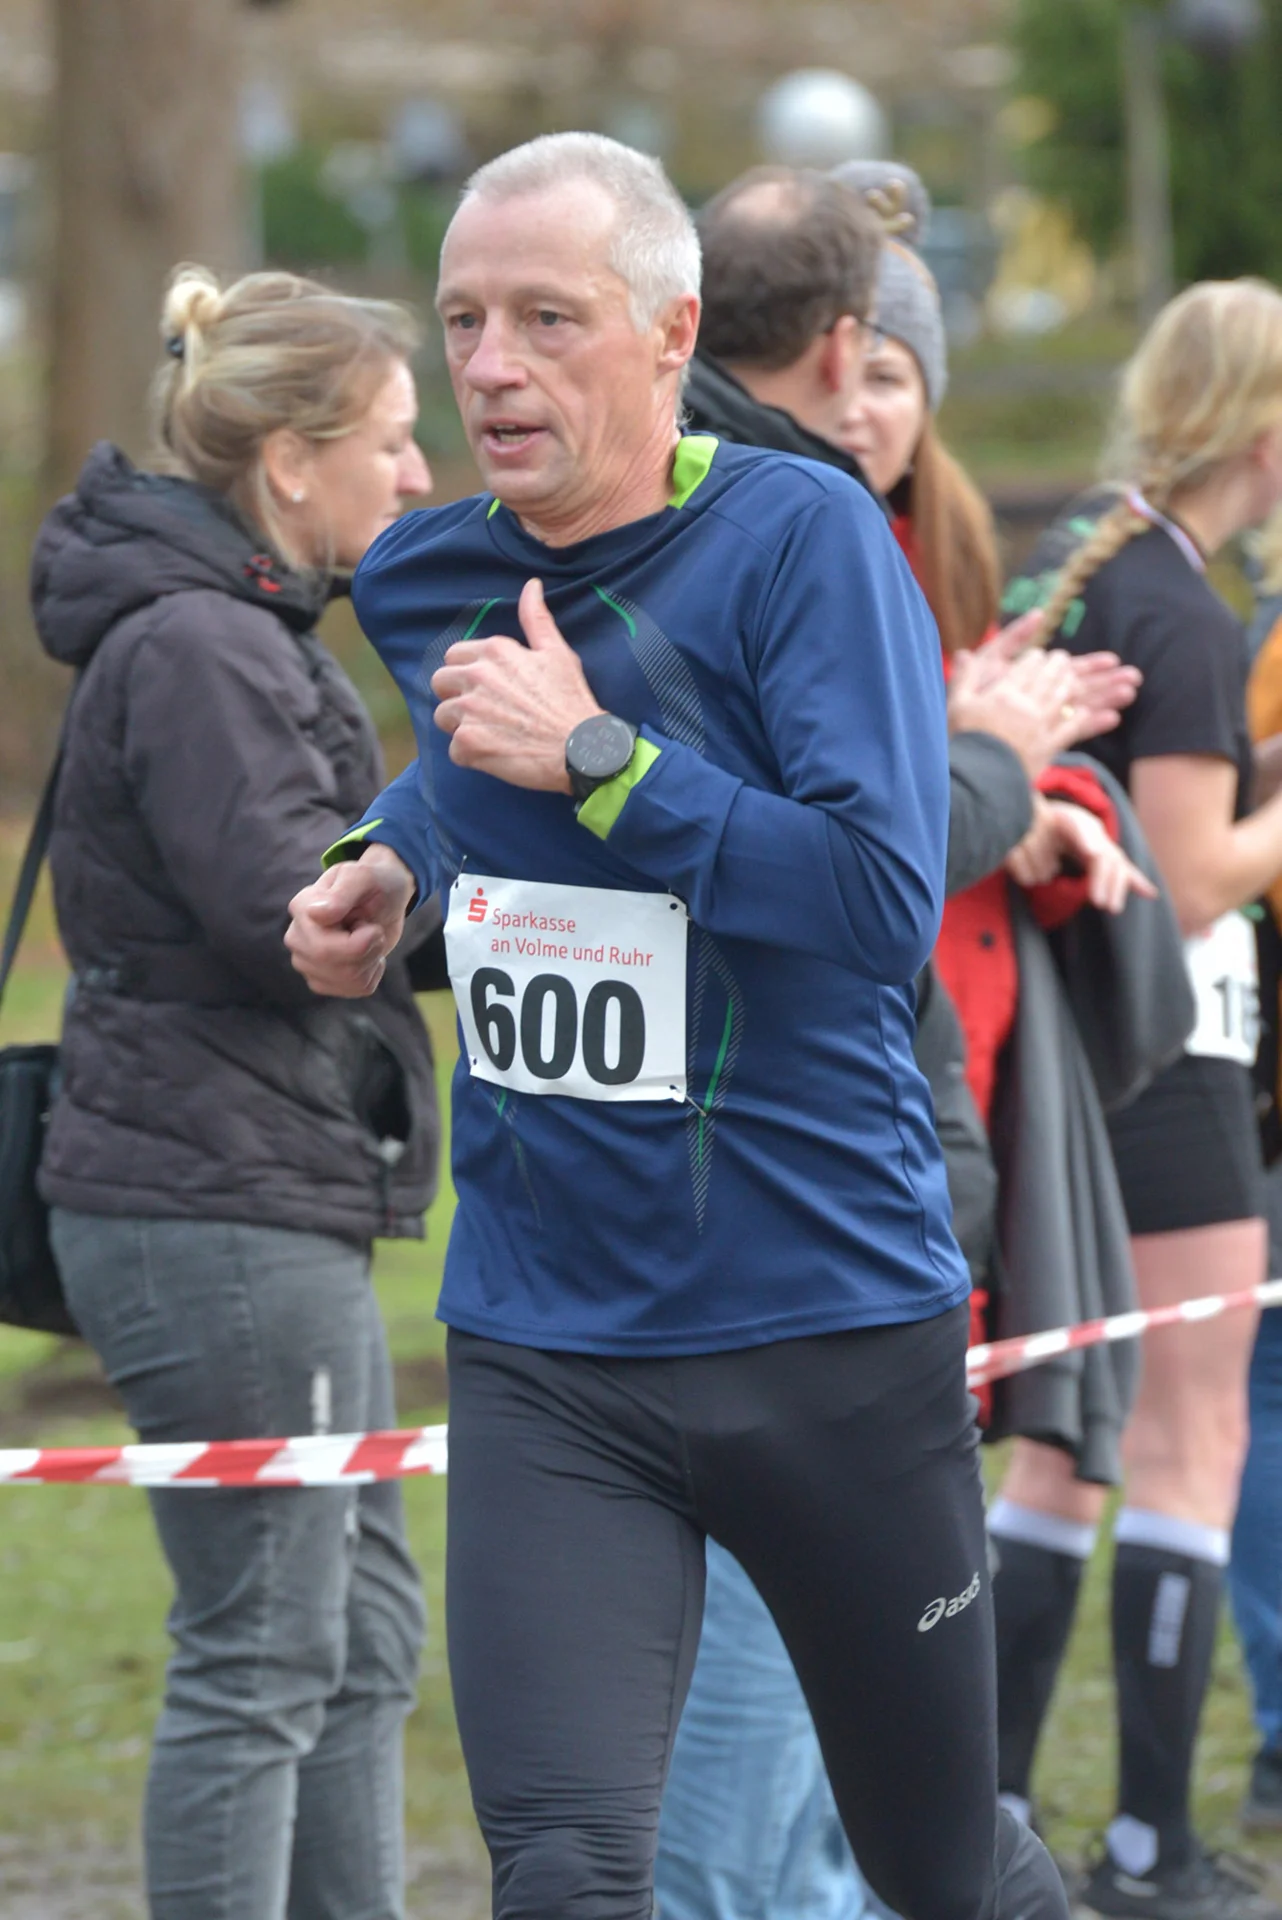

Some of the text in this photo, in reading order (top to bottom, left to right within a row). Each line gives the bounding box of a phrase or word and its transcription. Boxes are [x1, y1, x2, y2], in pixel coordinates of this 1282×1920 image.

[492, 908, 576, 933] Sparkasse
[491, 937, 654, 967] an Volme und Ruhr
[470, 966, 646, 1086] 600
